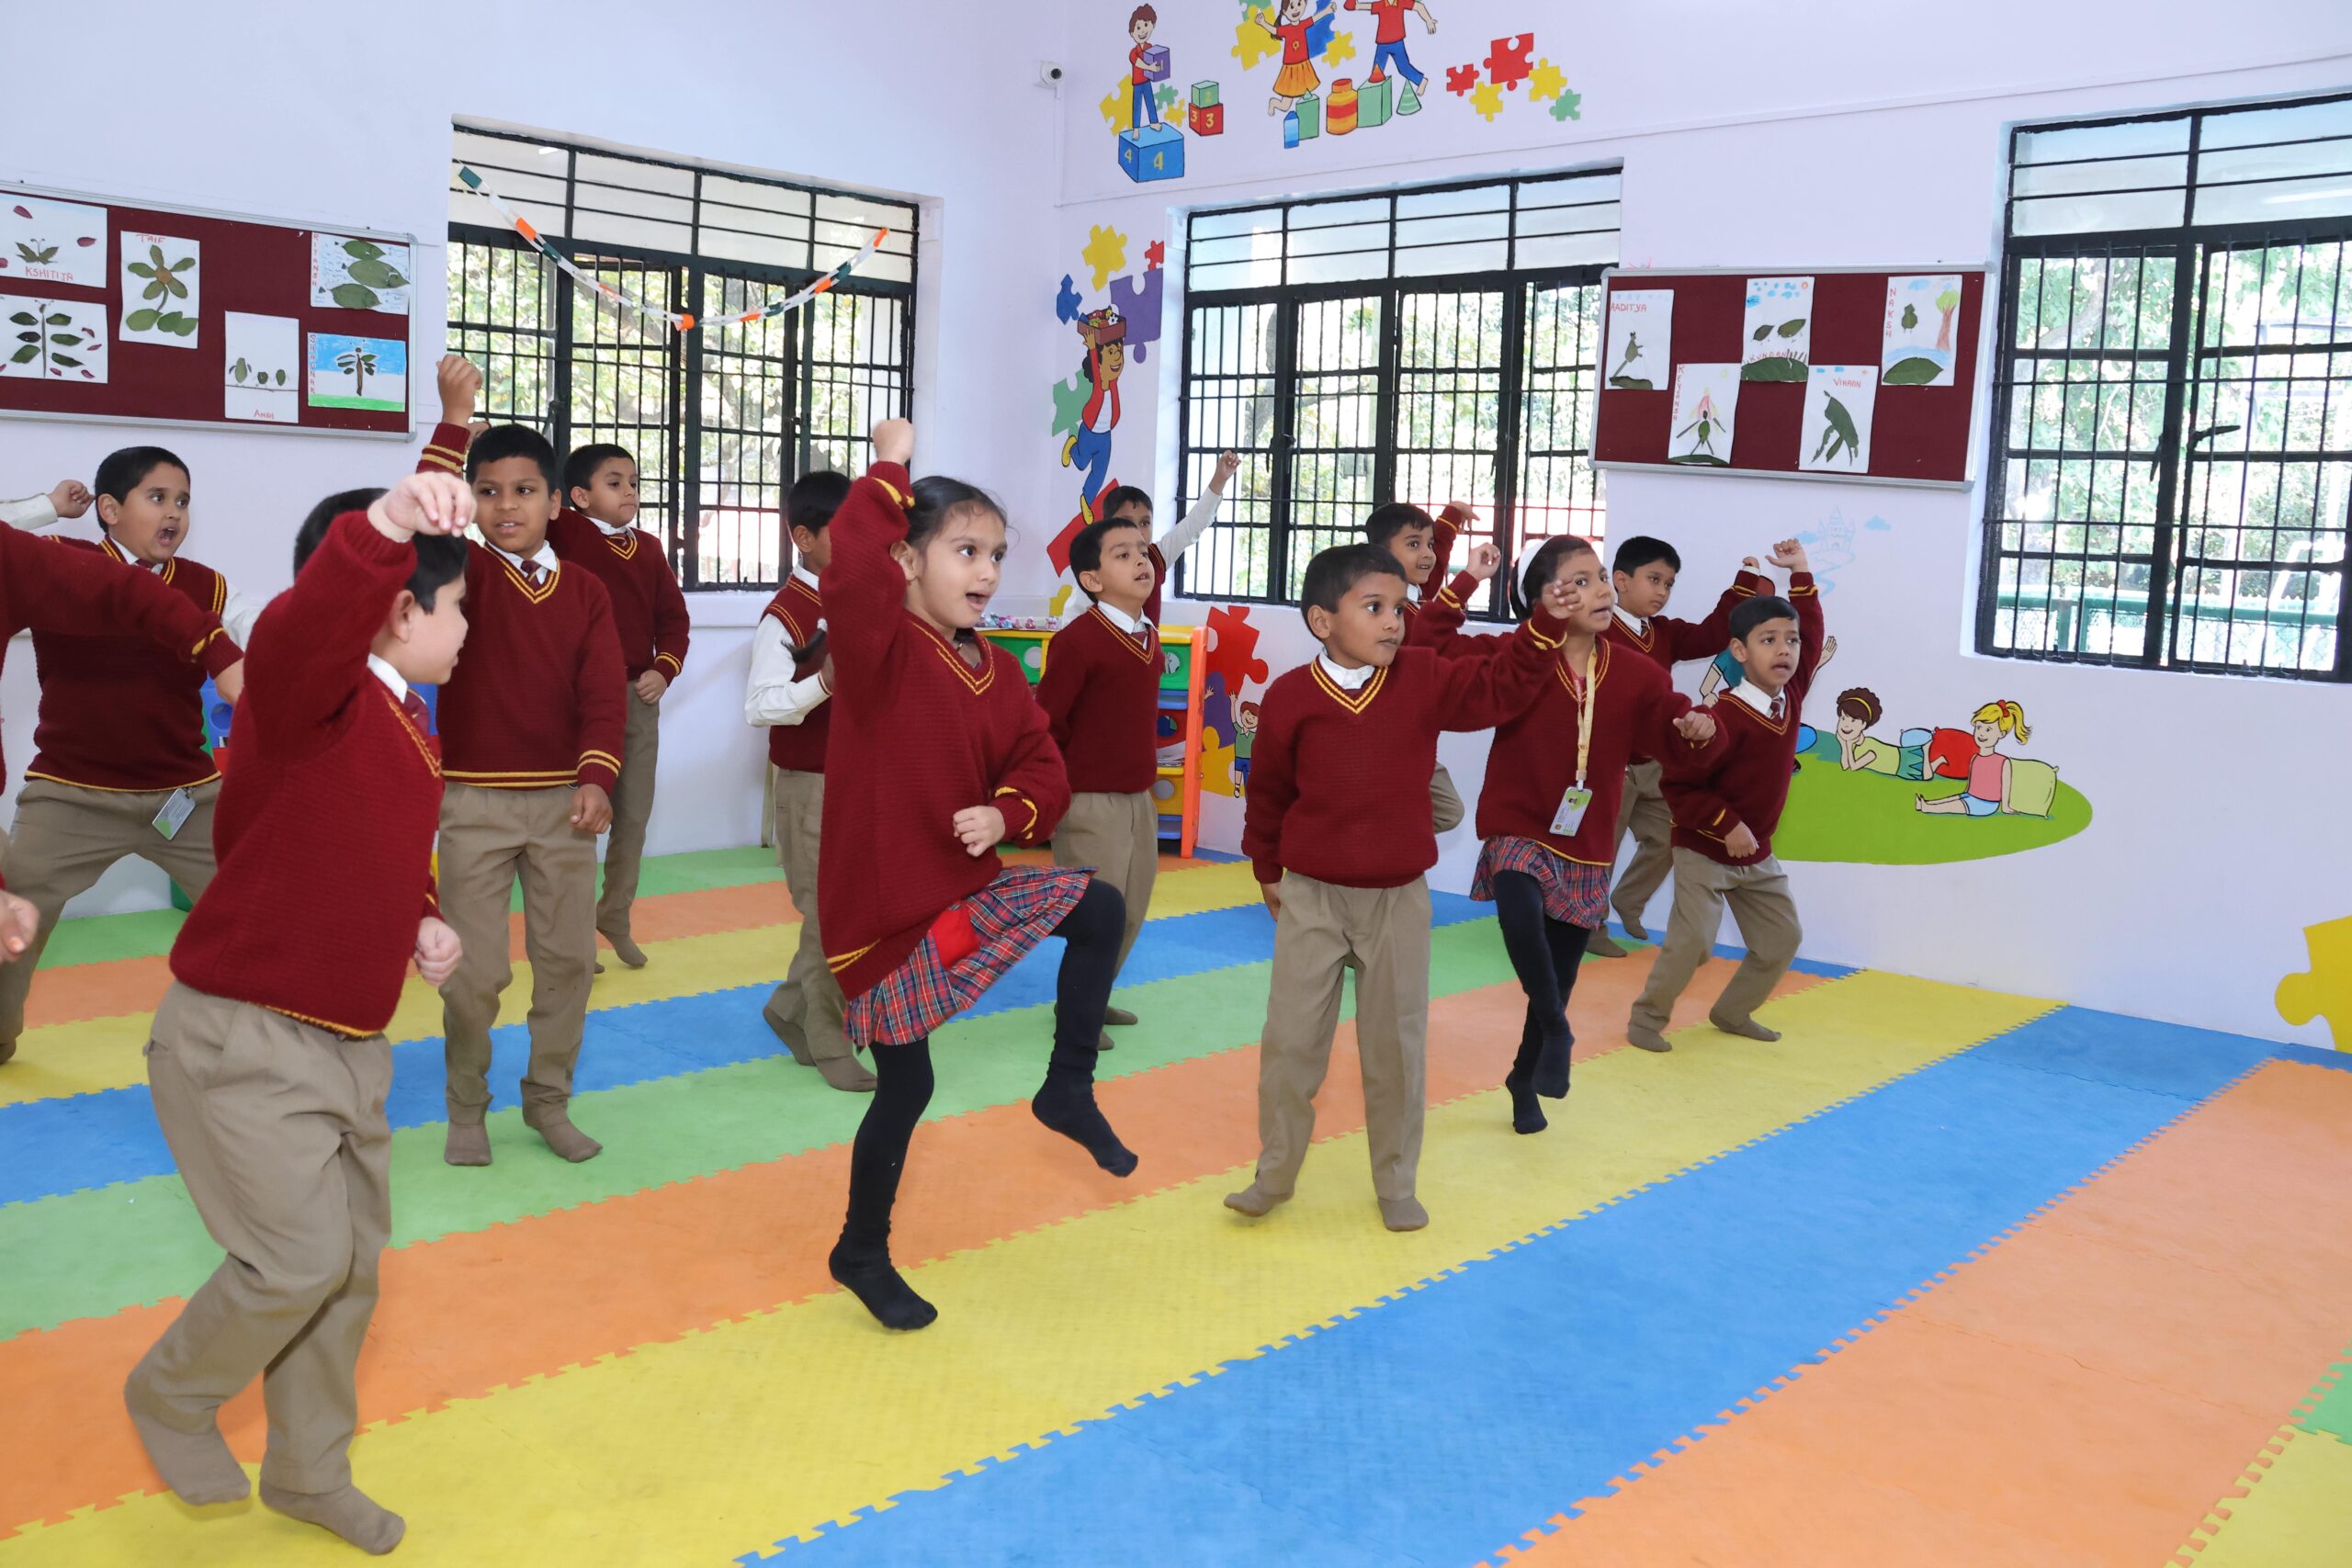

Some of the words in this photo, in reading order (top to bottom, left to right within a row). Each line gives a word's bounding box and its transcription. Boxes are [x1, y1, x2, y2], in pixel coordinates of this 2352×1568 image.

[1204, 92, 1212, 103] 2
[1190, 110, 1198, 122] 3
[1205, 112, 1215, 129] 3
[1125, 148, 1133, 164] 4
[1153, 151, 1164, 171] 4
[25, 265, 74, 282] KSHITIJA
[1610, 302, 1647, 313] AADITYA
[1885, 287, 1897, 338] NAKSH
